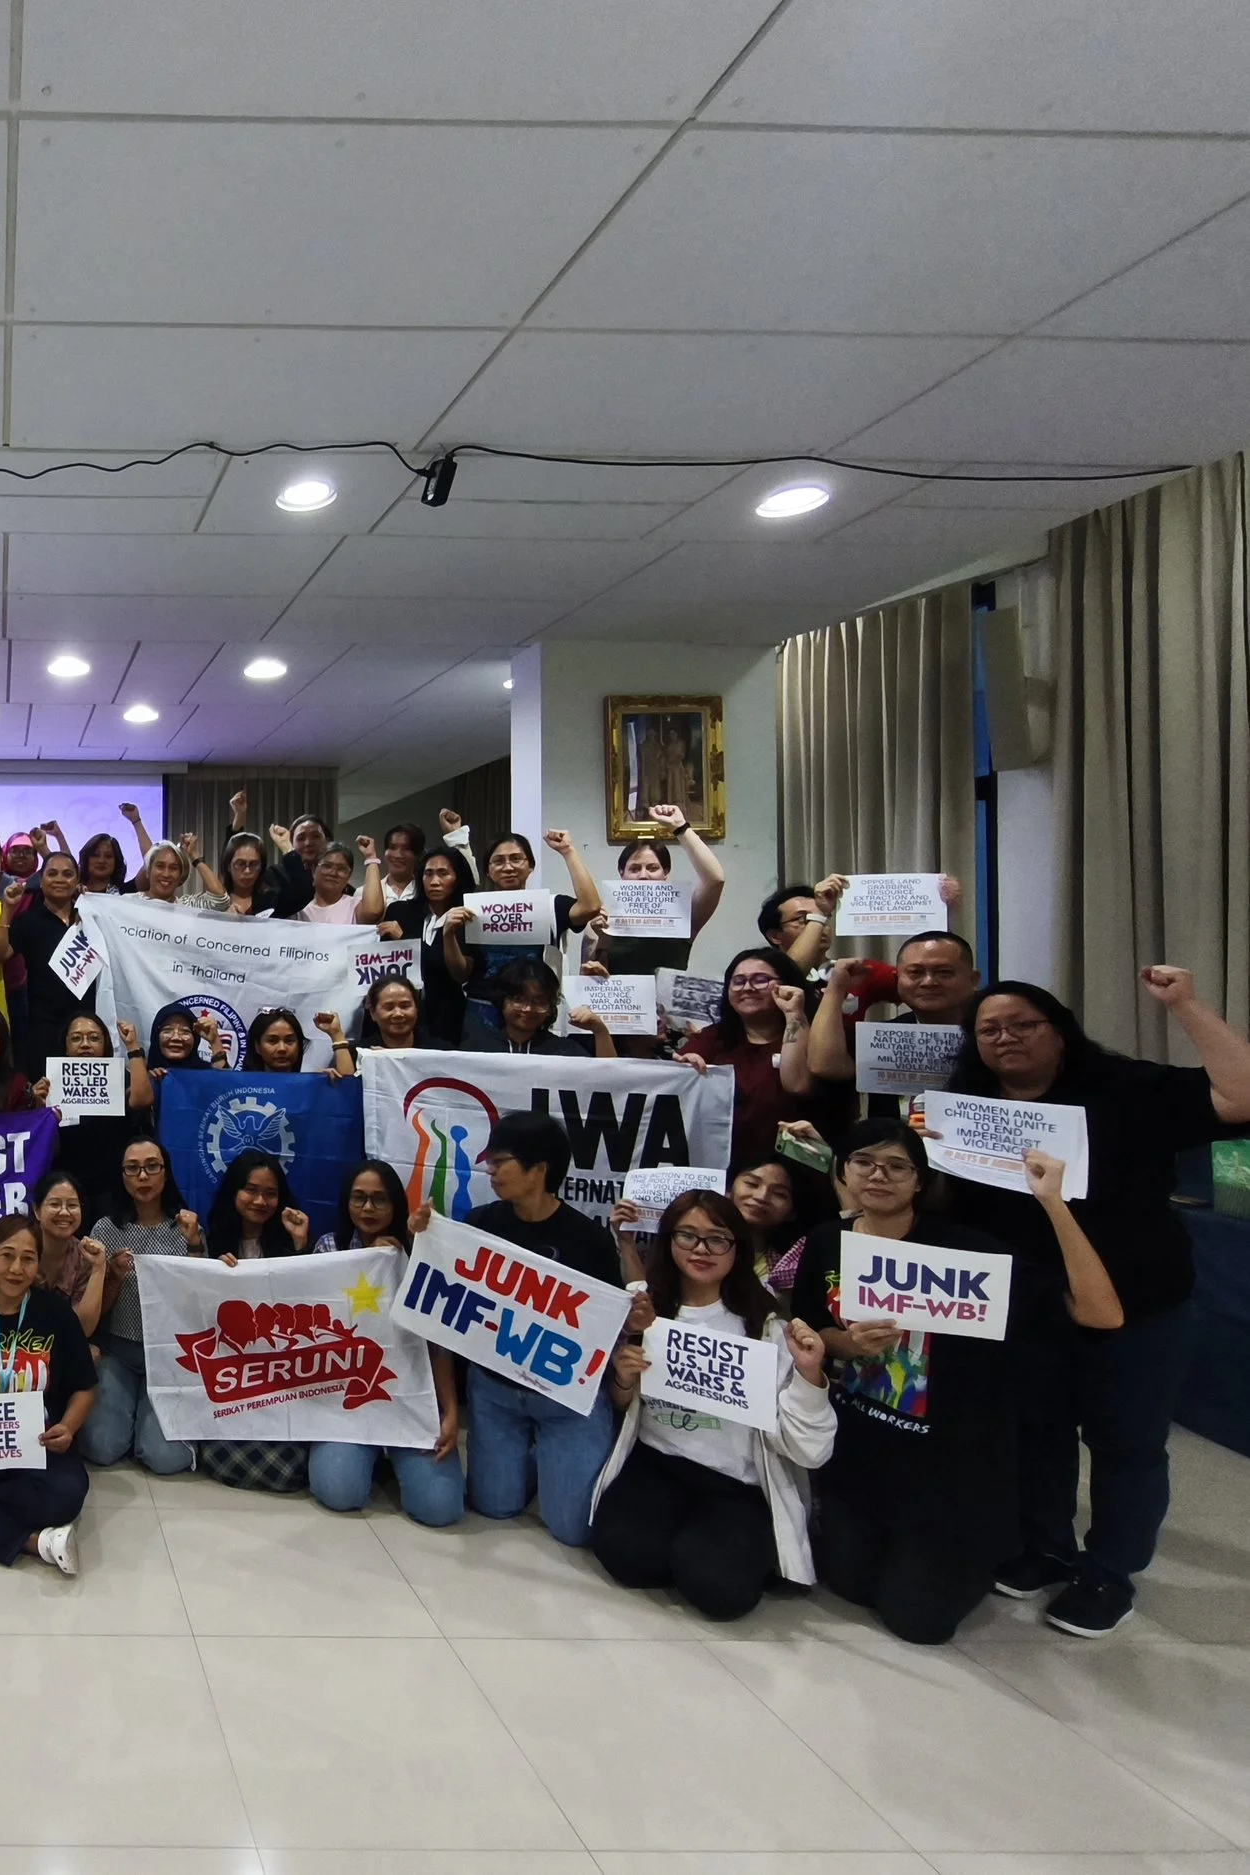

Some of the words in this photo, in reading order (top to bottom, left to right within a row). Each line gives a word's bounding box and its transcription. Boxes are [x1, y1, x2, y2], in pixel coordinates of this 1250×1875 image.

[481, 903, 533, 914] WOMEN
[490, 914, 523, 924] OVER
[482, 922, 533, 933] PROFIT!
[59, 929, 92, 977] JUNK
[174, 934, 188, 946] of
[196, 936, 270, 957] Concerned
[279, 946, 330, 962] Filipinos
[355, 949, 412, 967] IMF-WB!
[172, 961, 183, 973] in
[191, 965, 246, 983] Thailand
[873, 1036, 915, 1044] NATURE
[876, 1030, 917, 1038] EXPOSE
[870, 1042, 916, 1050] MILITARY
[893, 1050, 936, 1058] VICTIMS
[62, 1063, 110, 1077] RESIST
[877, 1056, 924, 1064] MILITARY
[62, 1077, 85, 1087] U.S.
[87, 1077, 108, 1087] LED
[62, 1087, 97, 1098] WARS
[99, 1087, 109, 1098] &
[210, 1090, 235, 1108] BURUH
[234, 1087, 276, 1095] INDONESIA
[944, 1108, 1010, 1127] CHILDREN
[1014, 1119, 1058, 1134] UNITE
[956, 1101, 1009, 1116] WOMEN
[1013, 1109, 1044, 1122] AND
[956, 1127, 1041, 1149] IMPERIALIST
[973, 1121, 990, 1132] TO
[994, 1125, 1023, 1137] END
[962, 1137, 1023, 1155] VIOLENC
[651, 1171, 681, 1179] ACTION
[697, 1175, 718, 1183] END
[673, 1179, 711, 1189] CAUSES
[454, 1246, 590, 1329] JUNK
[857, 1255, 991, 1301] JUNK
[859, 1285, 987, 1322] IMF-WB!
[404, 1261, 606, 1386] IMF-WB!
[667, 1328, 749, 1366] RESIST
[214, 1345, 366, 1394] SERUNI
[666, 1349, 703, 1372] U.S.
[708, 1359, 744, 1381] LED
[667, 1363, 725, 1392] WARS
[730, 1381, 746, 1399] &
[213, 1404, 245, 1419] SERIKAT
[246, 1392, 298, 1411] PEREMPUAN
[299, 1383, 346, 1400] INDONESIA
[665, 1379, 749, 1409] AGGRESSIONS
[868, 1407, 930, 1434] WORKERS
